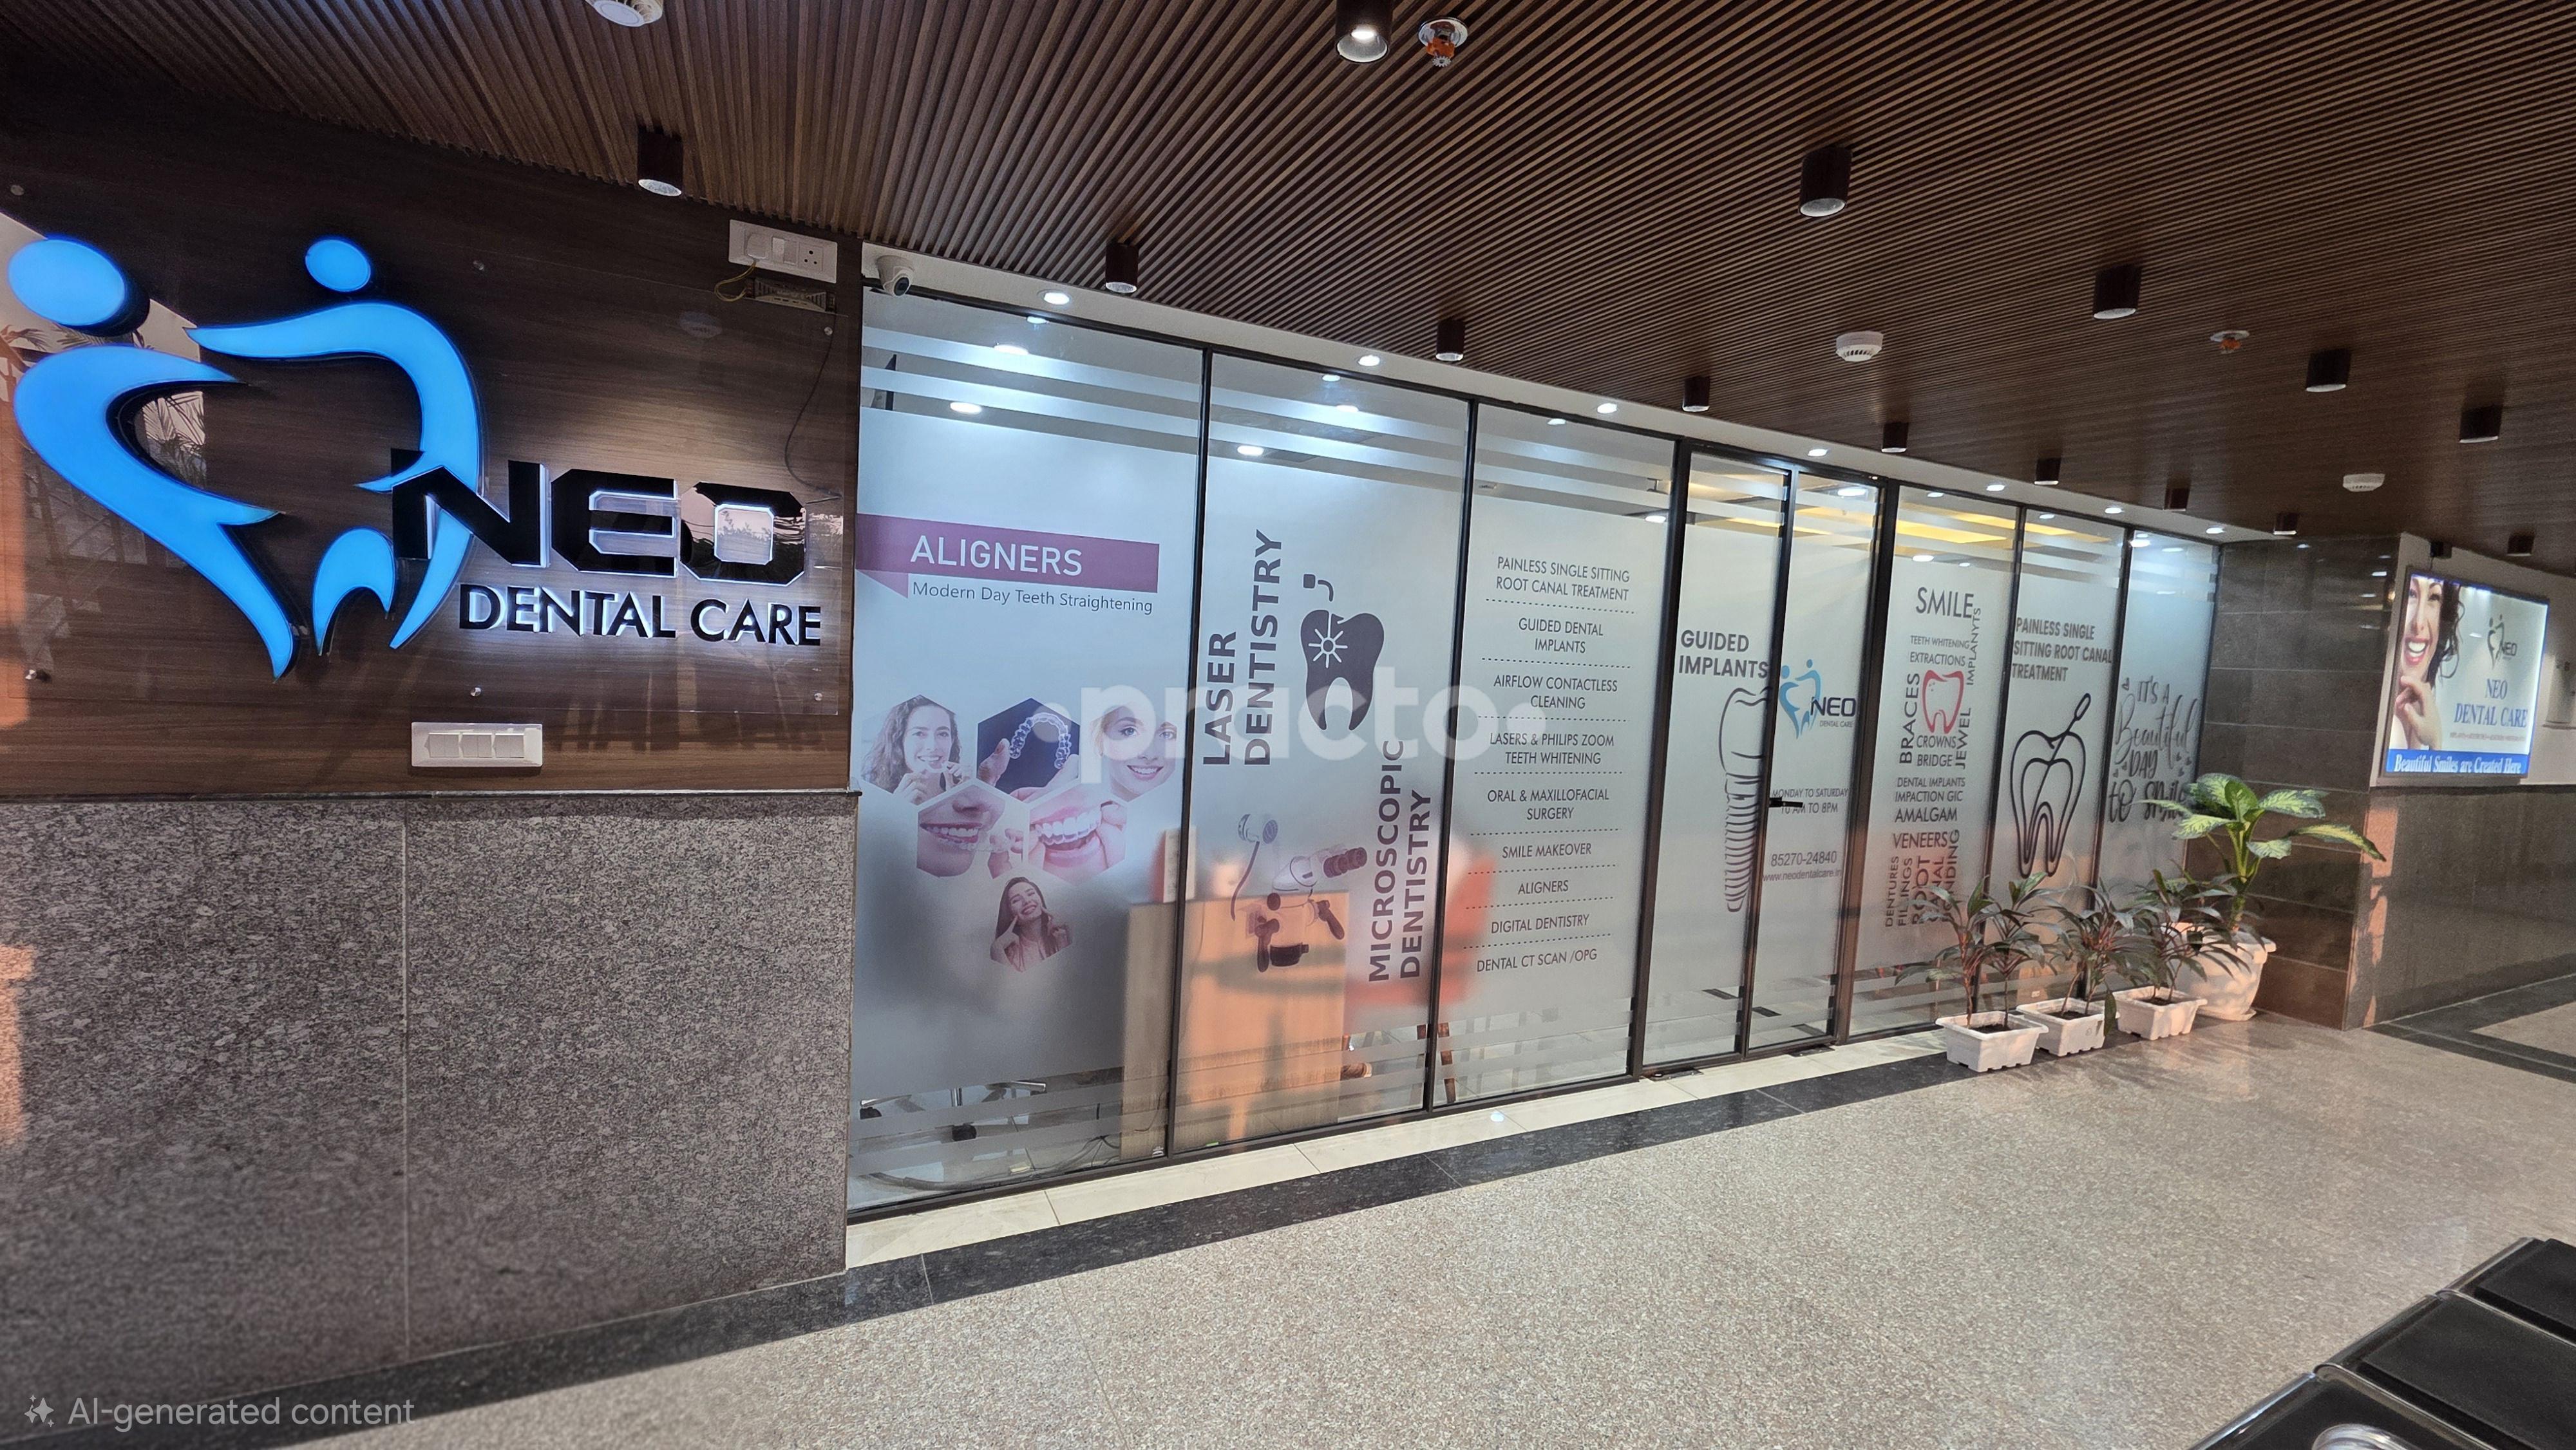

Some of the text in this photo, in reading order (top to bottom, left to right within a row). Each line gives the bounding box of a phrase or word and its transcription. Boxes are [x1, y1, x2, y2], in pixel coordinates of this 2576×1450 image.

[390, 448, 805, 586] NEO
[910, 535, 1083, 577] ALIGNERS
[1497, 556, 1630, 583] PAINLESS SINGLE SITTING
[912, 581, 1152, 614] Modern Day Teeth Straightening
[1496, 576, 1629, 601] ROOT CANAL TREATMENT
[1915, 587, 1974, 619] SMILE
[459, 583, 822, 646] DENTAL CARE
[1519, 617, 1604, 636] GUIDED DENTAL
[2016, 617, 2096, 640] PAINLESS SINGLE
[1244, 529, 1282, 765] DENTISTRY
[1535, 638, 1586, 654] IMPLANTS
[1680, 629, 1749, 652] GUIDED
[1911, 635, 1969, 649] TEETH WHITENING
[1910, 651, 1965, 666] EXTRACTIONS
[2013, 640, 2112, 664] SITTING ROOT CANAL
[1678, 655, 1768, 679] IMPLANTS
[2012, 663, 2069, 682] TREATMENT
[1493, 675, 1618, 692] AIRFLOW CONTACTLESS
[2485, 679, 2508, 699] NEO
[1203, 631, 1236, 765] LASER
[1530, 695, 1586, 709] CLEANING
[2163, 684, 2170, 704] A
[1810, 697, 1857, 717] NEO
[2454, 703, 2528, 728] DENTAL CARE
[1899, 673, 1920, 764] BRACES
[1490, 733, 1615, 747] LASERS & PHILIPS ZOOM
[1955, 708, 1971, 769] JEWEL
[2115, 693, 2198, 769] Beautiful
[1916, 735, 1957, 749] CROWNS
[1506, 752, 1601, 764] TEETH WHITENING
[1917, 754, 1953, 767] BRIDGE
[2128, 749, 2159, 778] DAY
[2394, 753, 2432, 772] Beautiful
[2433, 756, 2459, 773] Smiles
[2460, 762, 2472, 773] are
[2474, 758, 2503, 773] Created
[1897, 777, 1965, 787] DENTAL IMPLANTS
[1487, 788, 1609, 802] ORAL & MAXILLOFACIAL
[1772, 787, 1850, 798] MONDAY TO SATURDAY
[1895, 790, 1963, 802] IMPACTION GIC
[1527, 807, 1574, 820] SURGERY
[1808, 802, 1819, 813] TO
[1822, 802, 1838, 813] 8PM
[1895, 807, 1958, 823] AMALGAM
[1893, 831, 1948, 849] VENEERS
[1502, 843, 1591, 858] SMILE MAKEOVER
[1770, 851, 1837, 867] 85270-24840
[1368, 740, 1404, 982] MICROSCOPIC
[1400, 789, 1432, 979] DENTISTRY
[1518, 880, 1569, 895] ALIGNERS
[1885, 856, 1899, 927] DENTURES
[1492, 914, 1589, 934] DIGITAL DENTISTRY
[1477, 948, 1597, 972] DENTAL CT SCAN /OPG
